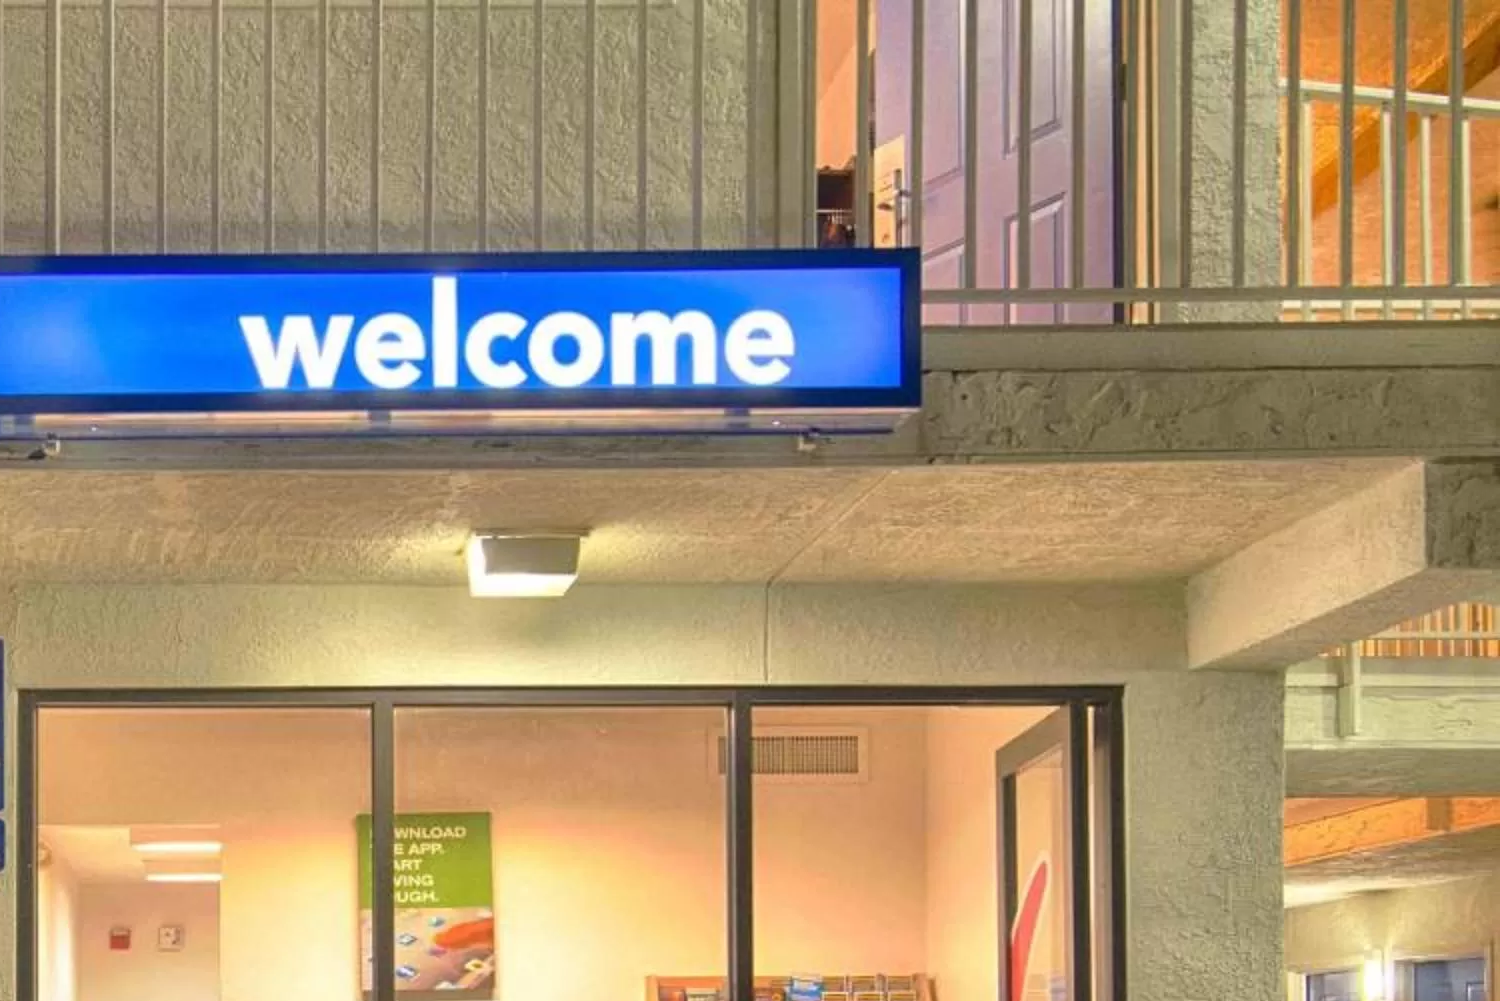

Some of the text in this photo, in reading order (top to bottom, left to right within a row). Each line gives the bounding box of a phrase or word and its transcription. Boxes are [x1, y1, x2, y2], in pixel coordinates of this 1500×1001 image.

[240, 275, 796, 389] welcome
[369, 826, 467, 839] WNLOAD
[408, 843, 446, 855] APP.
[393, 858, 423, 871] ART
[393, 874, 435, 887] VING
[394, 890, 440, 904] UGH.
